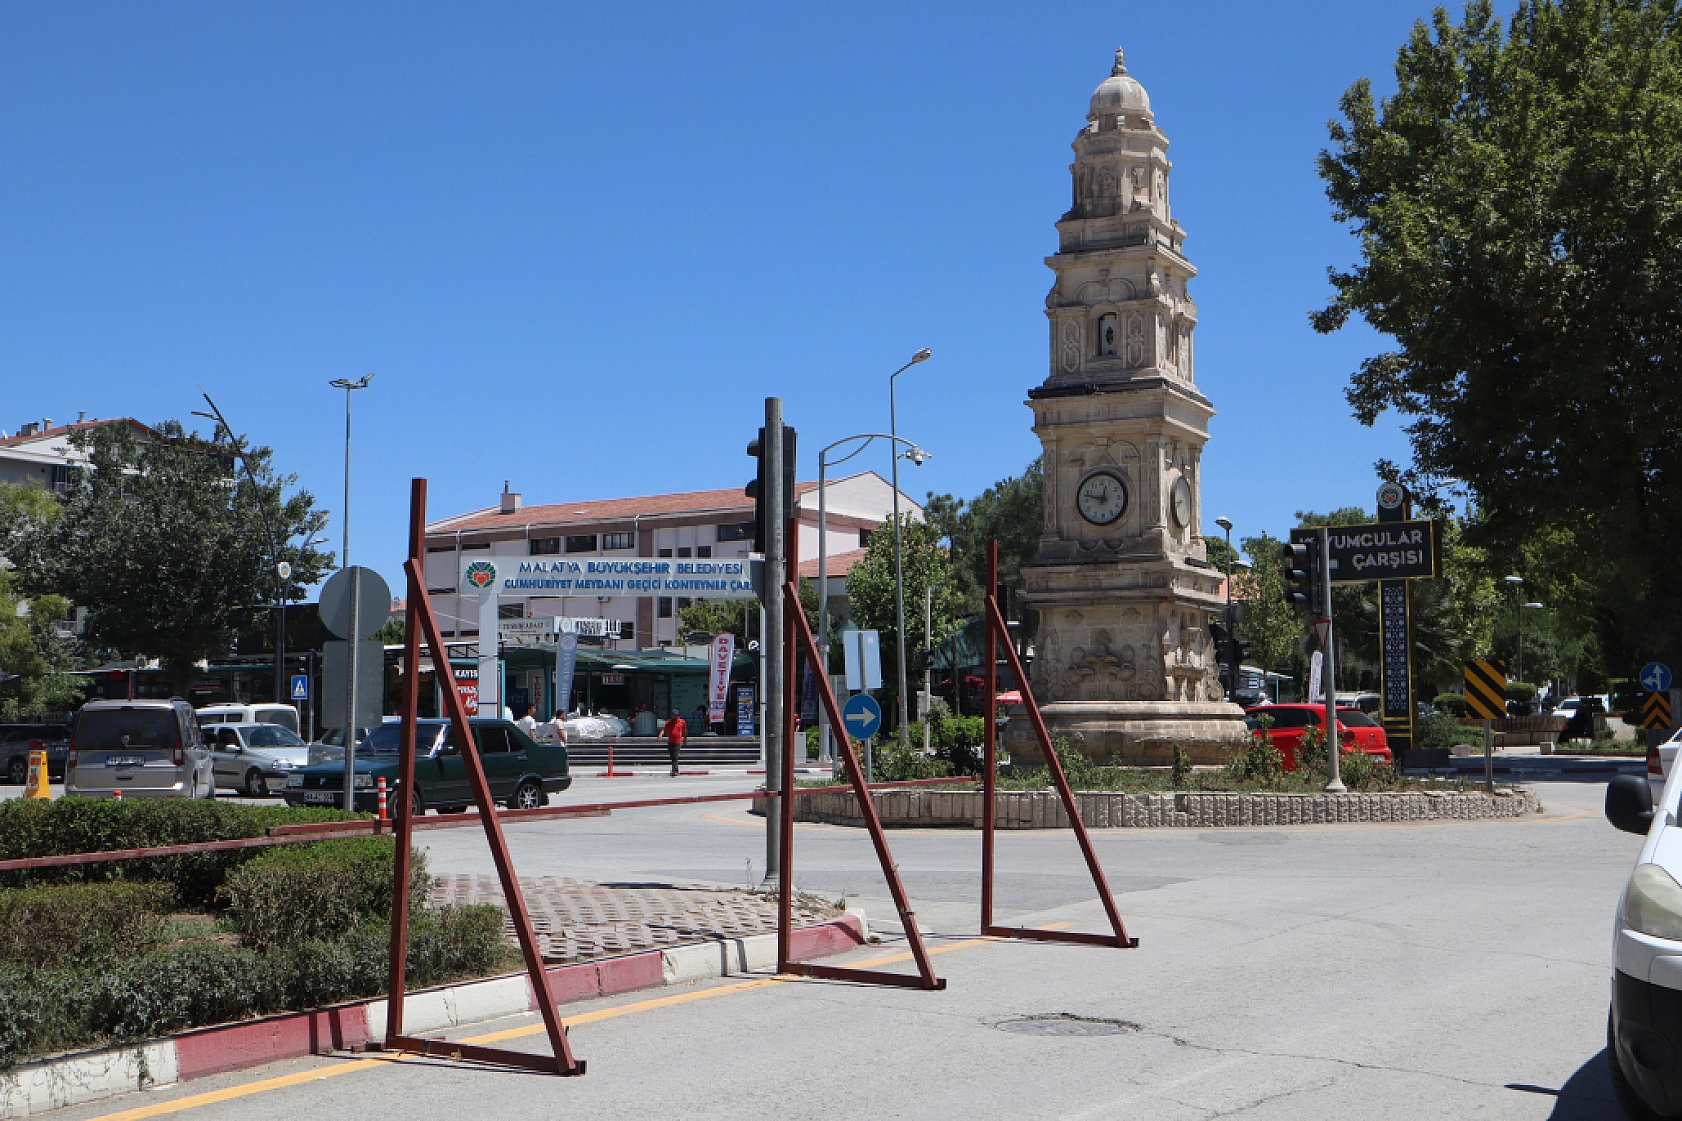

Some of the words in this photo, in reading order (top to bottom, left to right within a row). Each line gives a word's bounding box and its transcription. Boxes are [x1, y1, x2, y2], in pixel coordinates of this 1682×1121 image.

[519, 561, 583, 574] MALATYA
[1352, 550, 1423, 571] ÇARŞISI
[504, 576, 573, 590] CUMHURİYET
[575, 579, 624, 590] MEYDANI
[627, 576, 661, 592] GEÇİCİ
[664, 579, 727, 590] KONTEYNER
[730, 579, 756, 594] ÇAR
[716, 637, 730, 701] DAVETİYE
